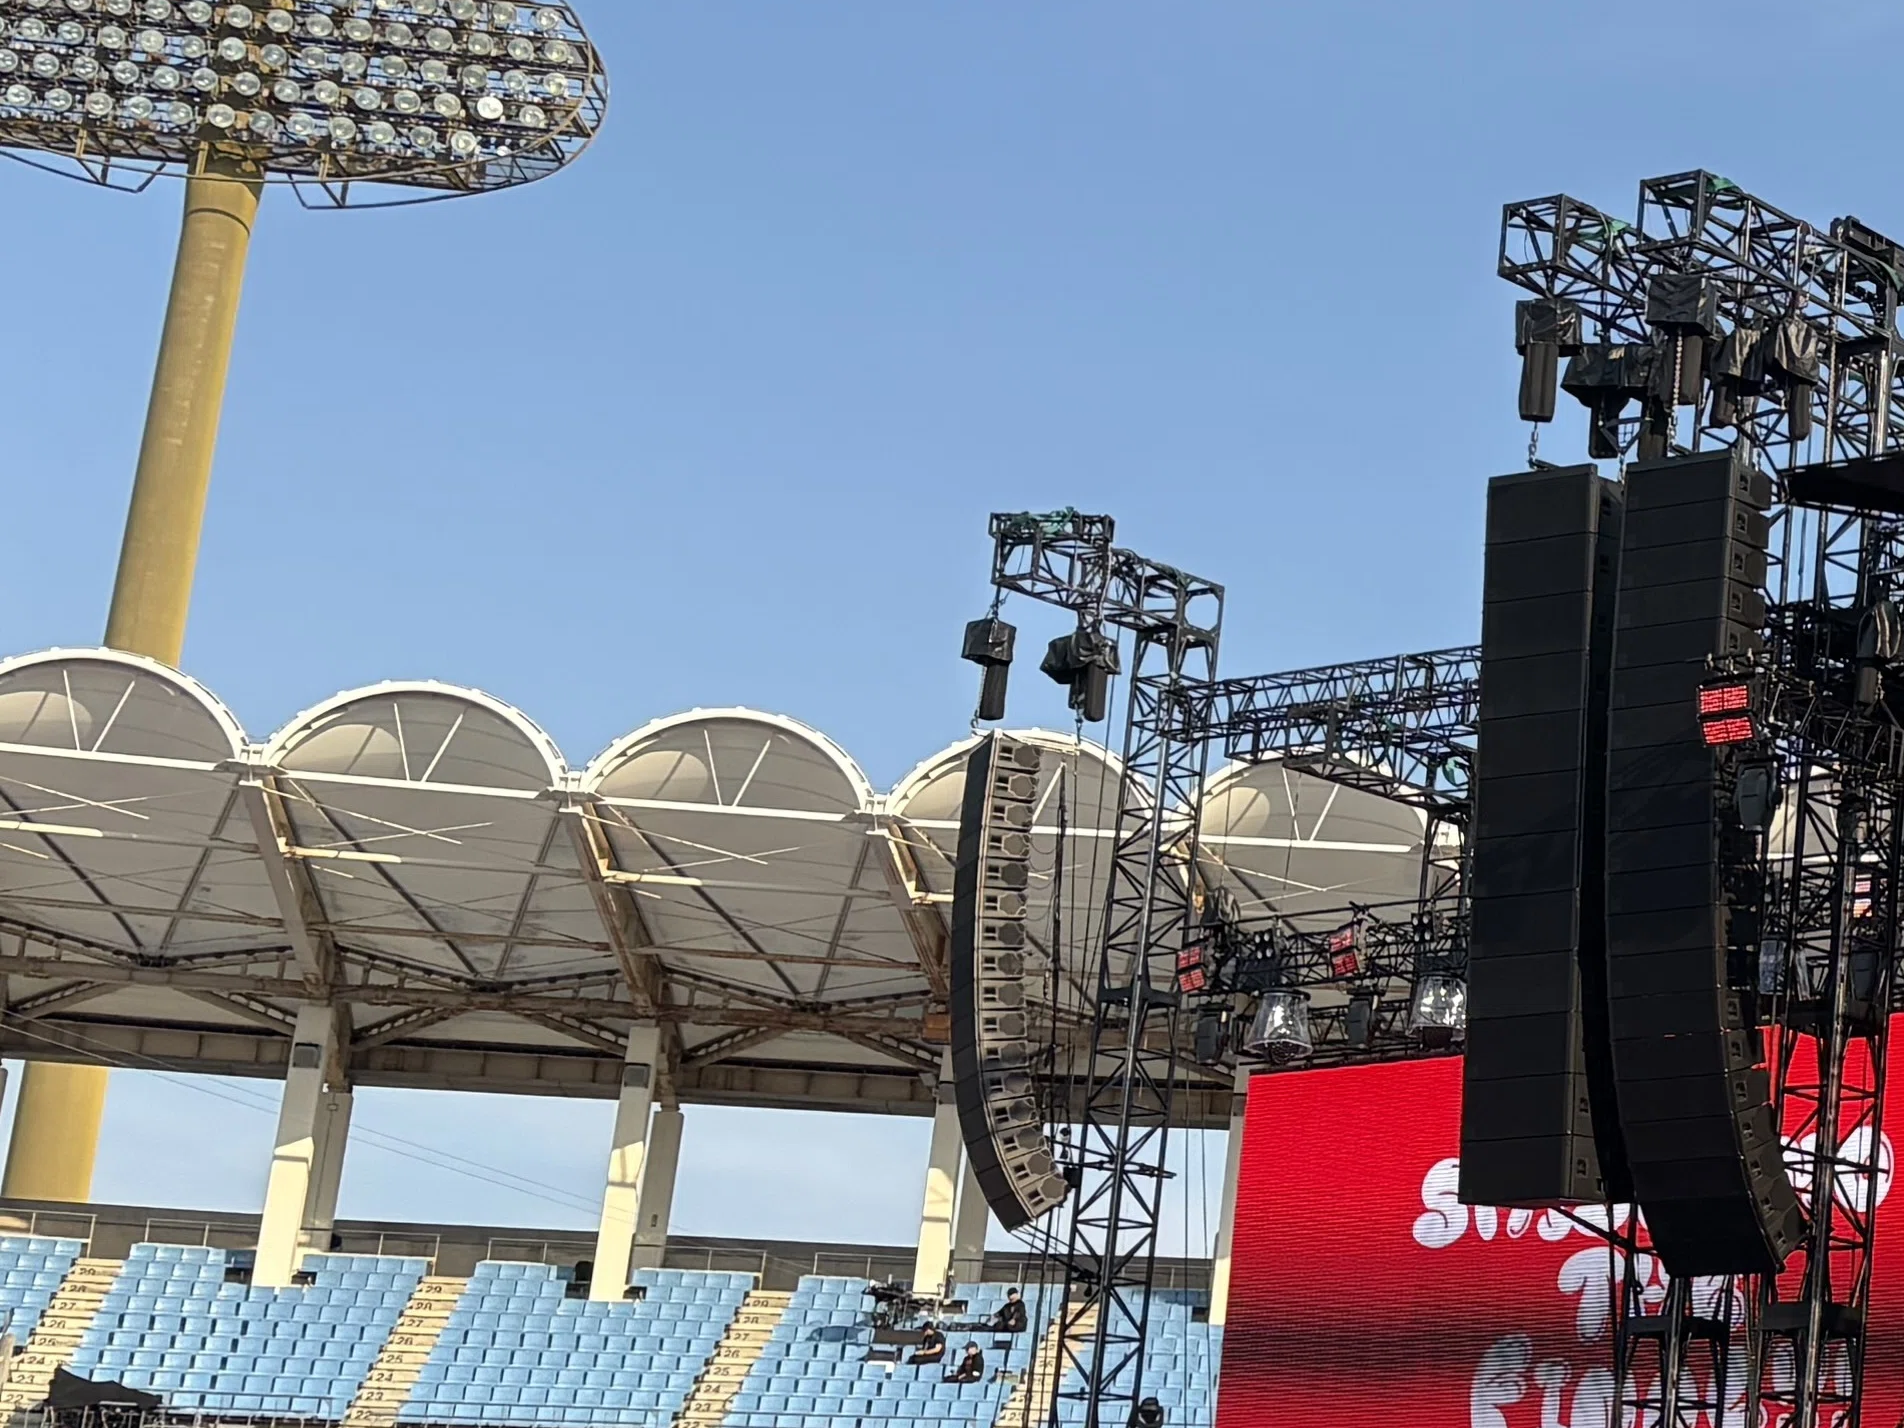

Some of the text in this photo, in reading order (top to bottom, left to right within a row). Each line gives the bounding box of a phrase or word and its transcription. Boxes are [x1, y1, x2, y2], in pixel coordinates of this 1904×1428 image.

[407, 1319, 423, 1327] 27
[17, 1375, 35, 1384] 23
[376, 1373, 393, 1382] 24
[703, 1384, 721, 1393] 24
[5, 1394, 23, 1403] 22
[366, 1391, 384, 1400] 23
[694, 1403, 711, 1412] 23
[355, 1410, 371, 1419] 22
